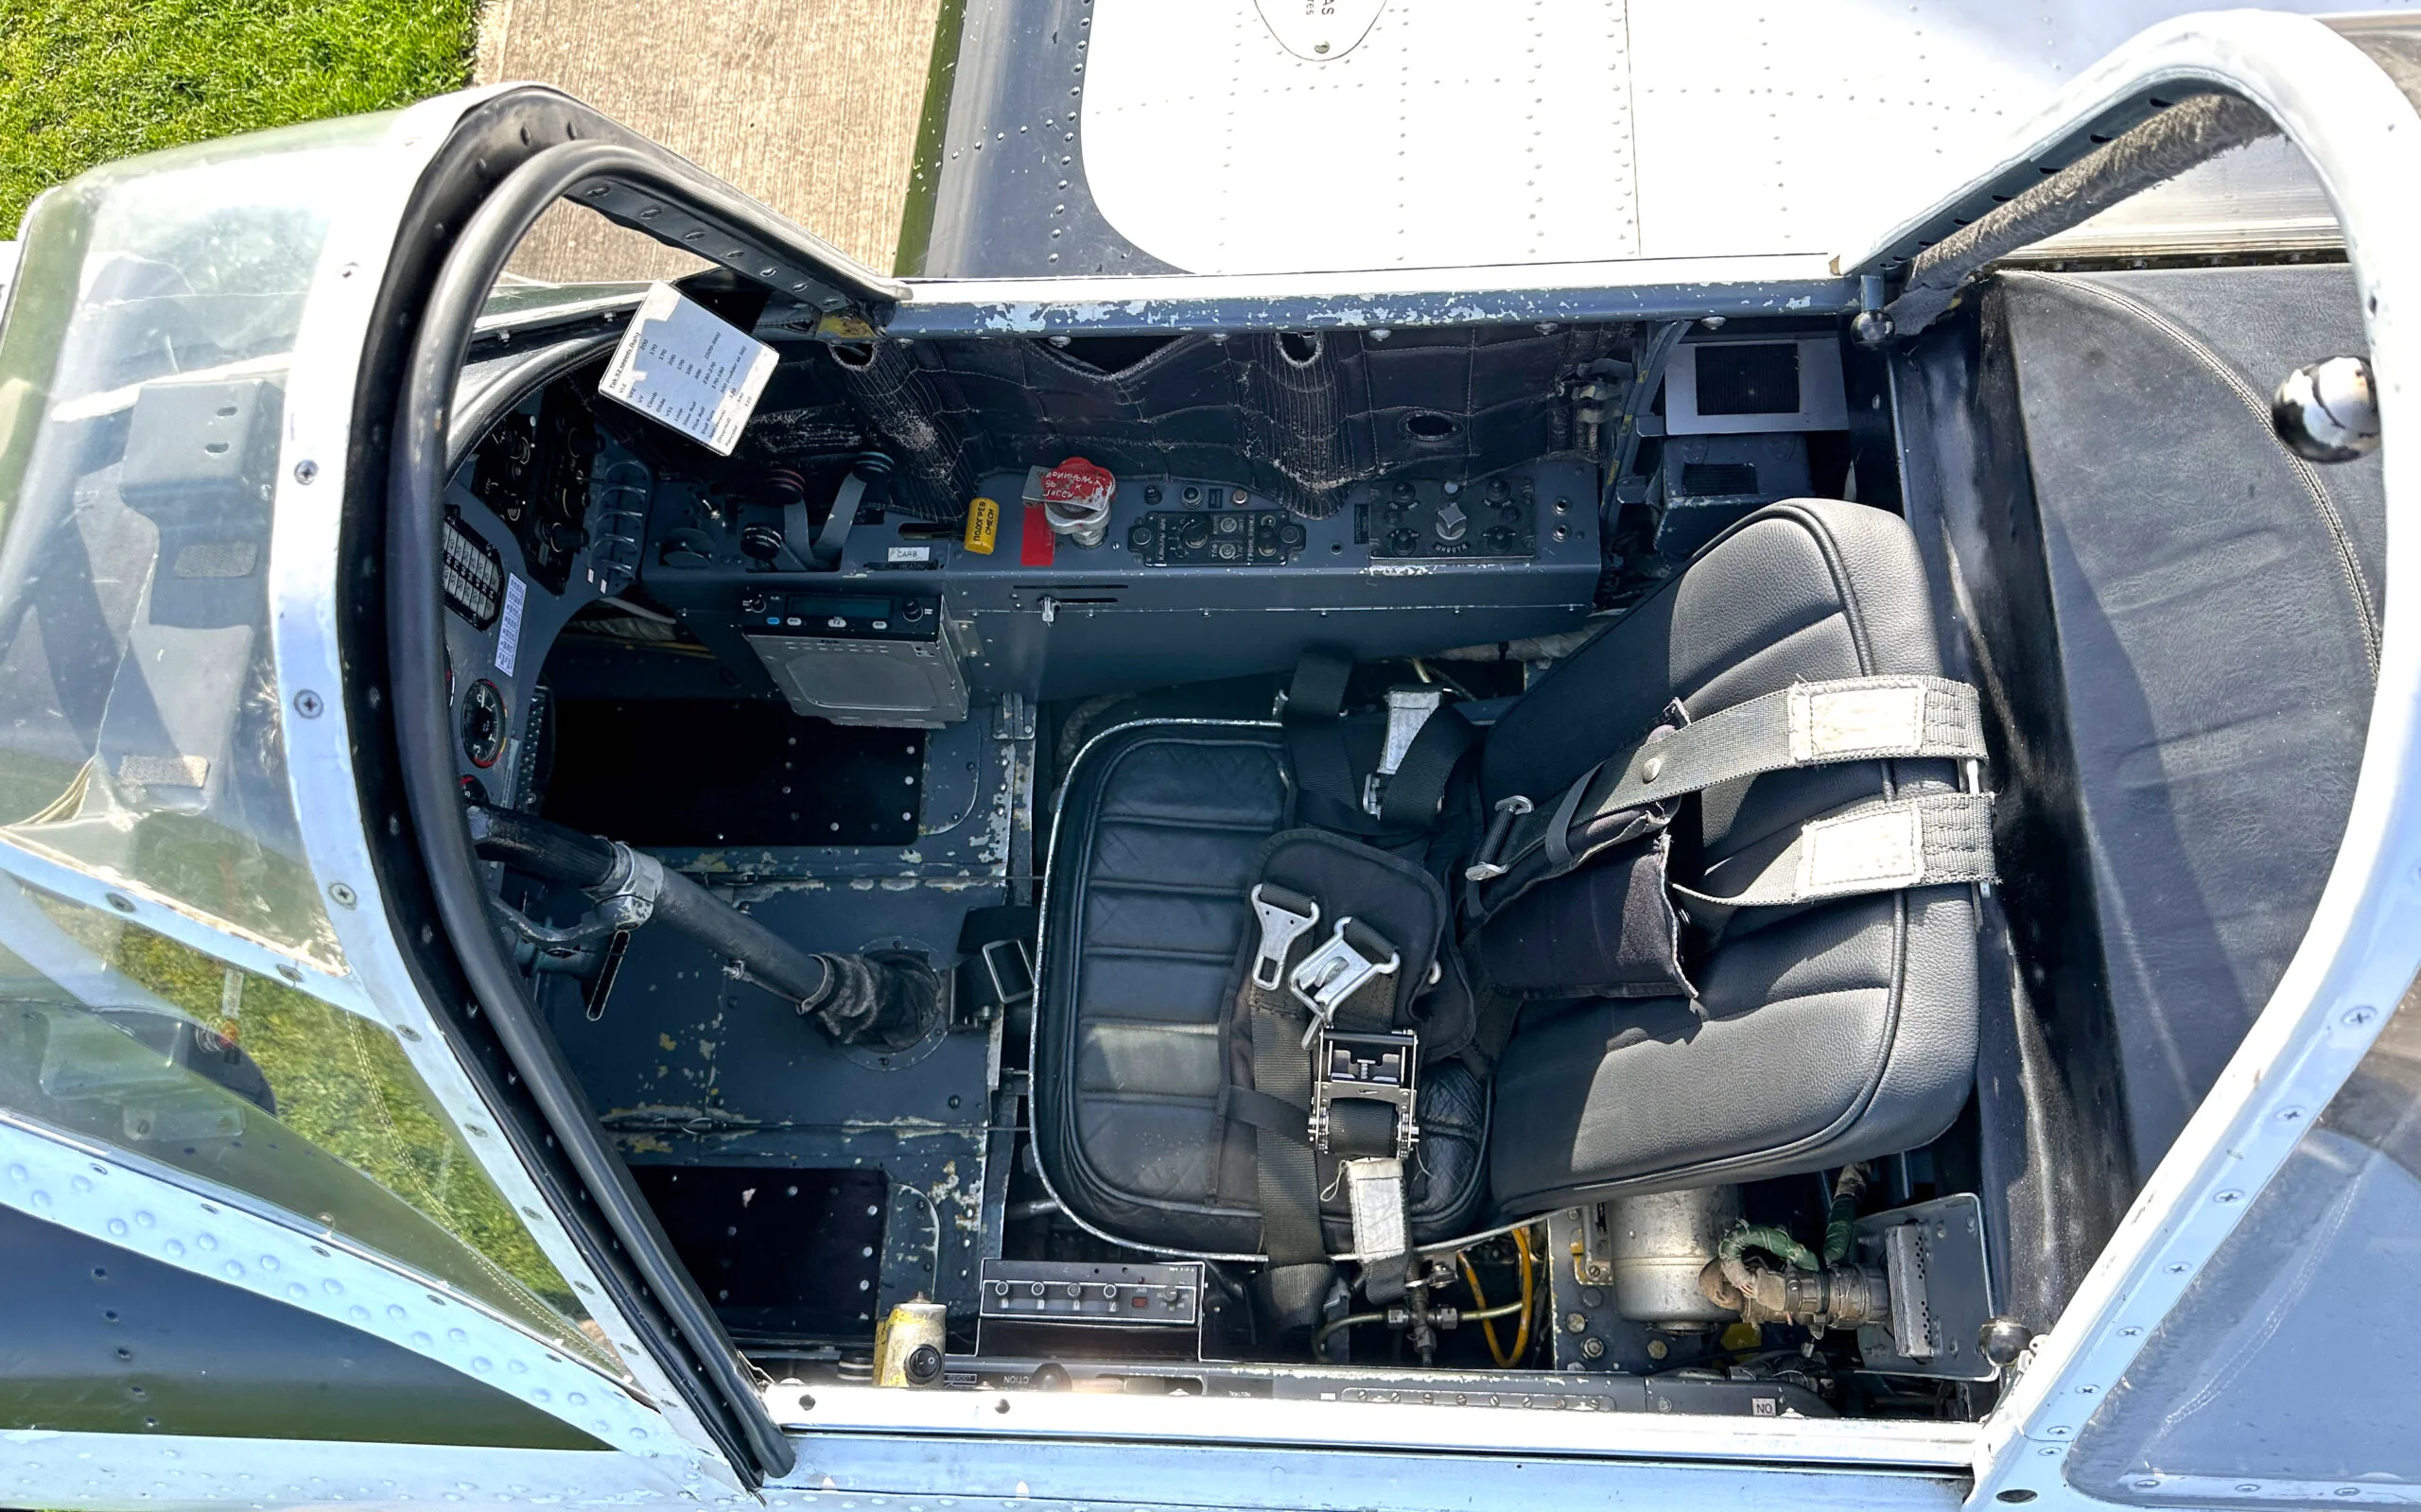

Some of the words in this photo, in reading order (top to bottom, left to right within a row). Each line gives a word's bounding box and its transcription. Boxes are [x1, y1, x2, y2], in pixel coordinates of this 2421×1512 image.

[640, 339, 649, 351] 200
[650, 344, 658, 356] 170
[619, 349, 634, 369] speeds
[658, 349, 667, 360] 170
[646, 391, 658, 408] Climb
[668, 354, 676, 366] 200
[655, 398, 666, 412] Glide
[676, 359, 686, 371] 170
[688, 401, 697, 412] Roll
[706, 409, 715, 422] Turn
[973, 501, 986, 542] ПОДОГРЕВ
[984, 508, 995, 535] СМЕСИ
[1003, 1375, 1029, 1383] CTION
[1756, 1403, 1771, 1414] NO
